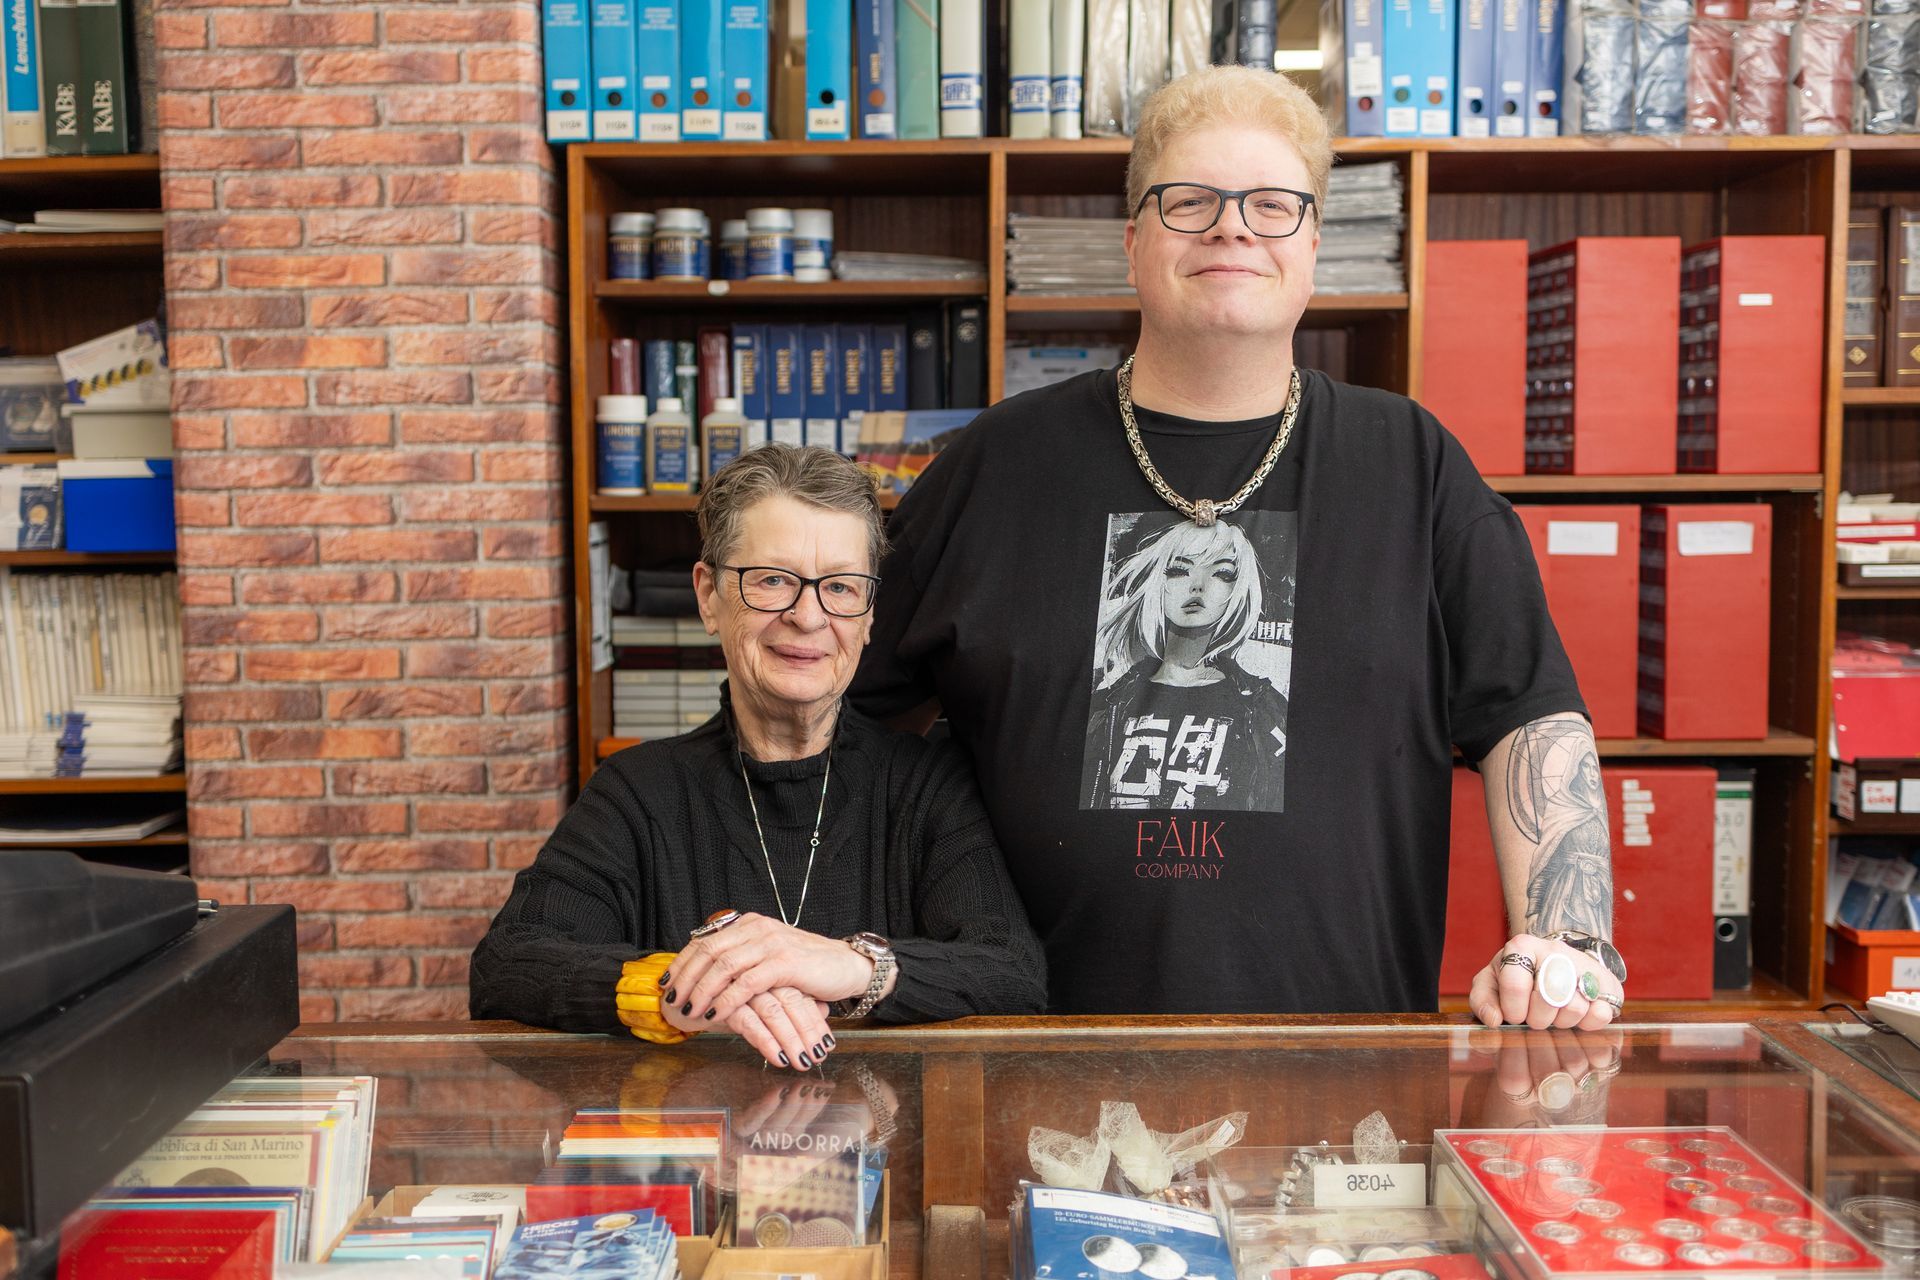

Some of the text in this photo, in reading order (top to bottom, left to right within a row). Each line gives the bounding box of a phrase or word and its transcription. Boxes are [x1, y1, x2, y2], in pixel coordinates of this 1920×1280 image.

[154, 1137, 304, 1152] bblica di San Marino
[523, 1219, 579, 1233] HEROES
